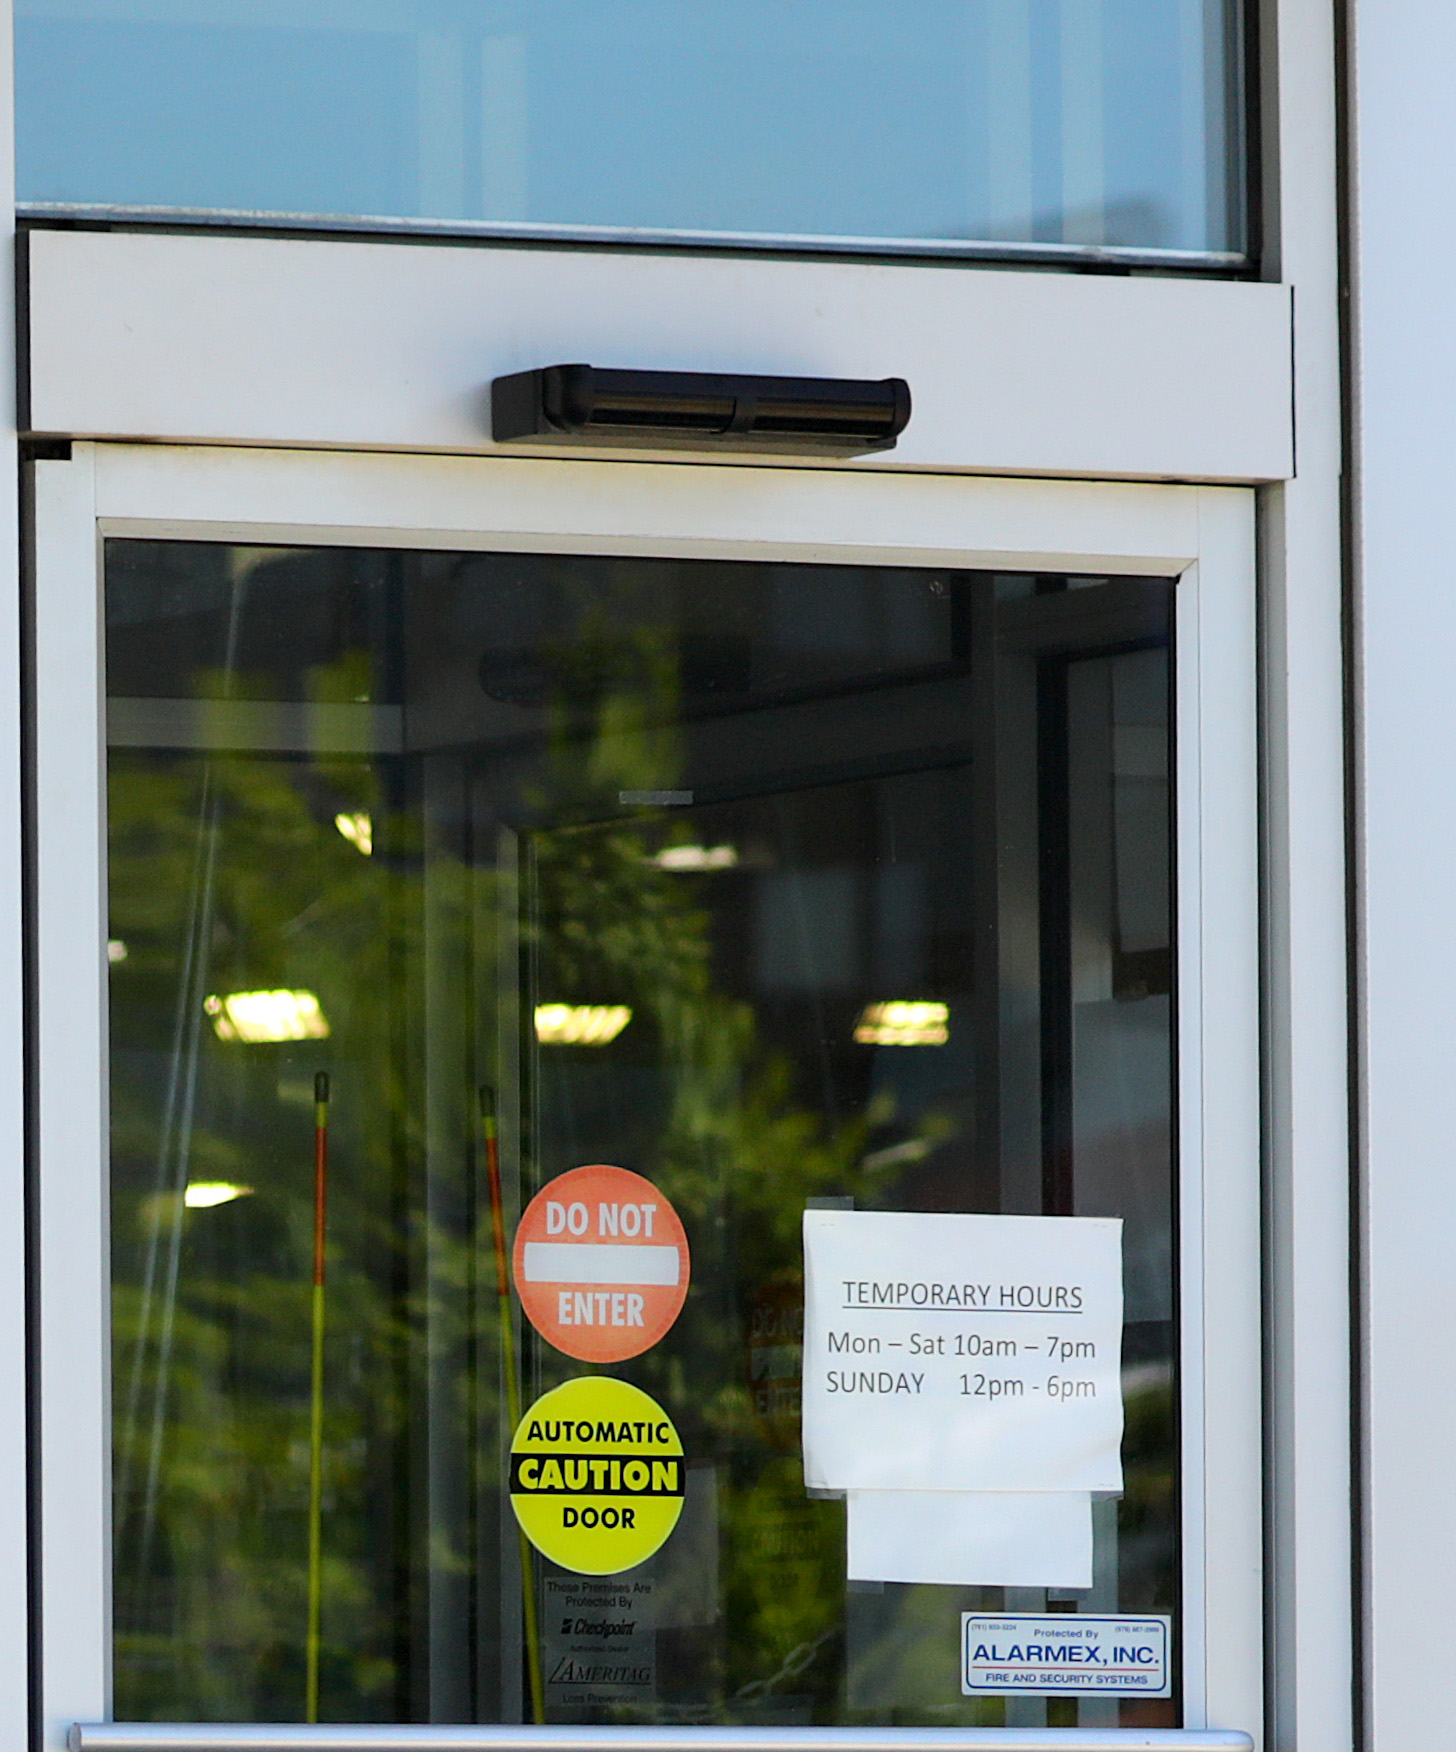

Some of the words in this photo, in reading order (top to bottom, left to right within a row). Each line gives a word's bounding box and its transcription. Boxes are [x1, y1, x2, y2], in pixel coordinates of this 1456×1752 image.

[546, 1201, 588, 1237] DO
[599, 1203, 657, 1238] NOT
[843, 1281, 991, 1308] TEMPORARY
[999, 1285, 1083, 1309] HOURS
[558, 1291, 645, 1327] ENTER
[827, 1332, 881, 1355] Mon
[909, 1332, 945, 1356] Sat
[954, 1334, 1017, 1357] 10am
[1046, 1336, 1096, 1363] 7pm
[826, 1371, 926, 1395] SUNDAY
[959, 1374, 1025, 1401] 12pm
[1046, 1375, 1097, 1402] 6pm
[527, 1421, 670, 1445] AUTOMATIC
[518, 1458, 678, 1492] CAUTION
[563, 1507, 635, 1529] DOOR
[547, 1581, 580, 1593] These
[582, 1581, 630, 1594] Premises
[633, 1582, 651, 1594] Are
[565, 1595, 616, 1608] Protected
[619, 1596, 633, 1609] By
[574, 1618, 637, 1639] Checkpoint
[1034, 1628, 1082, 1639] Protected
[1085, 1629, 1099, 1640] By
[973, 1645, 1109, 1667] ALARMEX,
[1113, 1647, 1160, 1665] INC.
[560, 1656, 651, 1682] AMERITAG
[985, 1672, 1010, 1683] FIRE
[1013, 1673, 1037, 1684] AND
[1039, 1673, 1094, 1685] SECURITY
[1096, 1675, 1149, 1685] SYSTEMS
